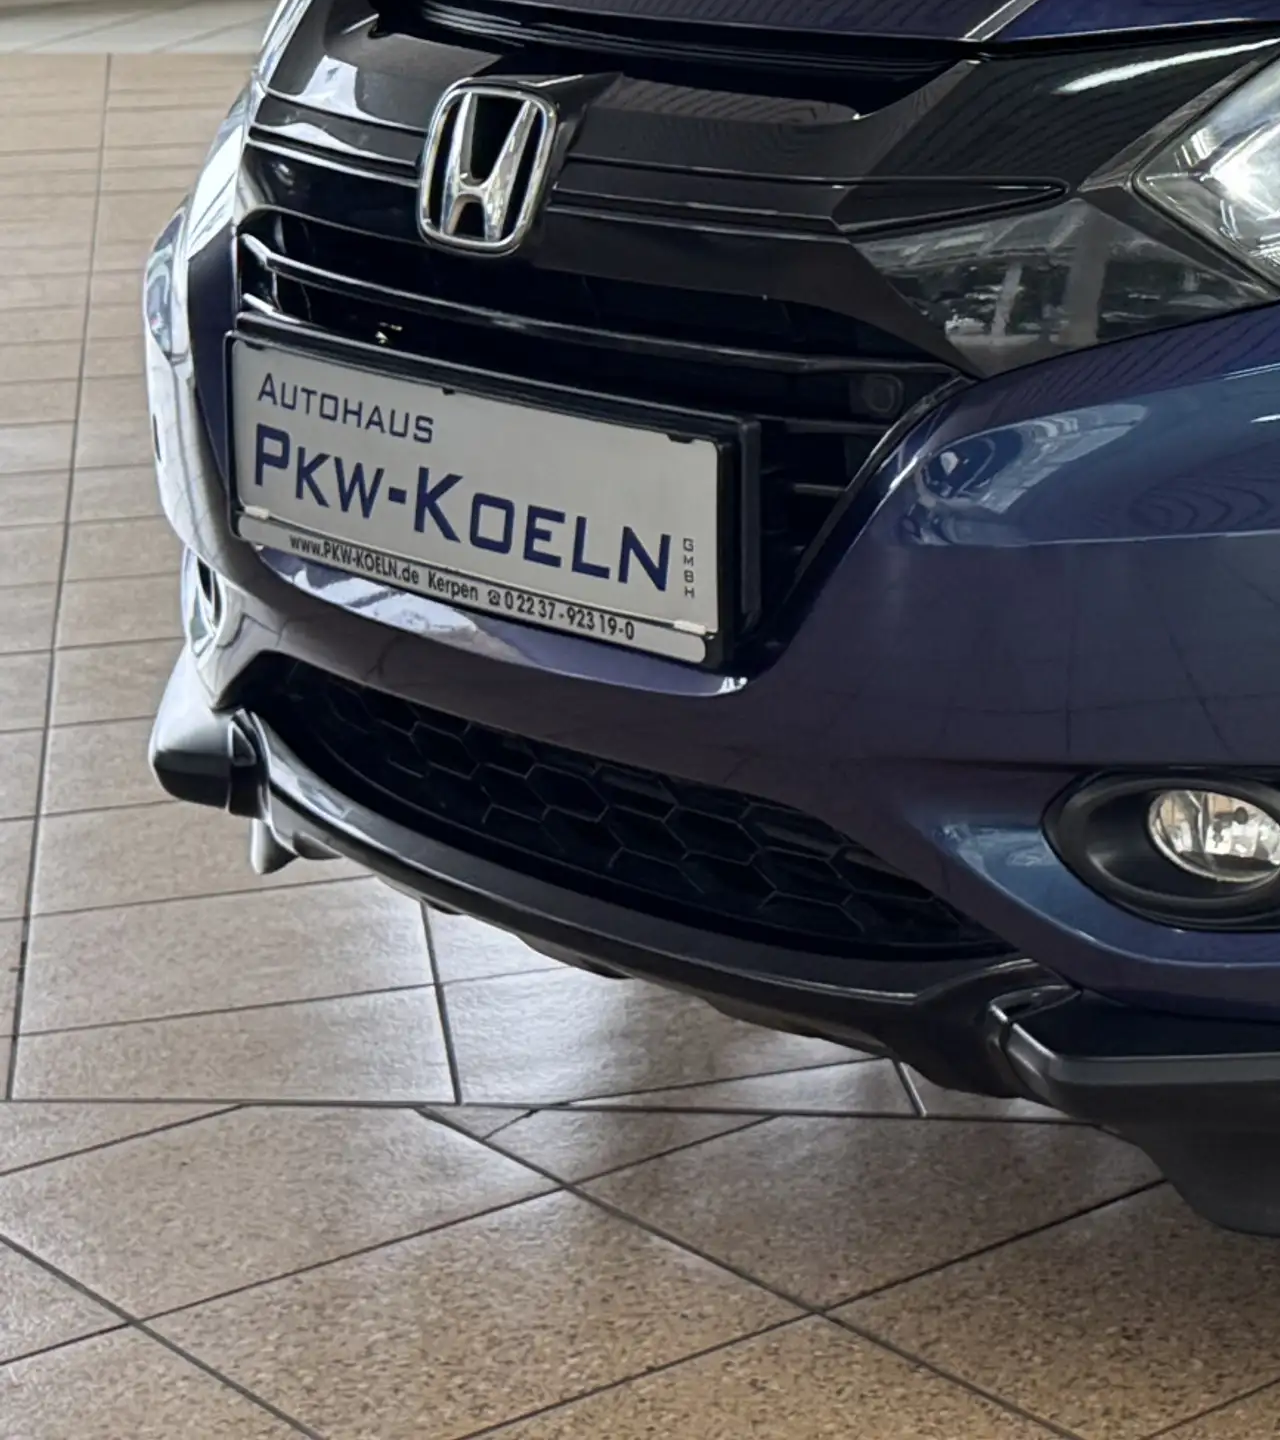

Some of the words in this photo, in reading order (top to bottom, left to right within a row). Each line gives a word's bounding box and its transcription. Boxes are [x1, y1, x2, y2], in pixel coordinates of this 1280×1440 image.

[257, 372, 434, 444] AUTOHAUS
[254, 423, 671, 592] PKW-KOELN
[289, 535, 419, 586] www.PKW-KOELN.de
[428, 570, 479, 602] Kerpen
